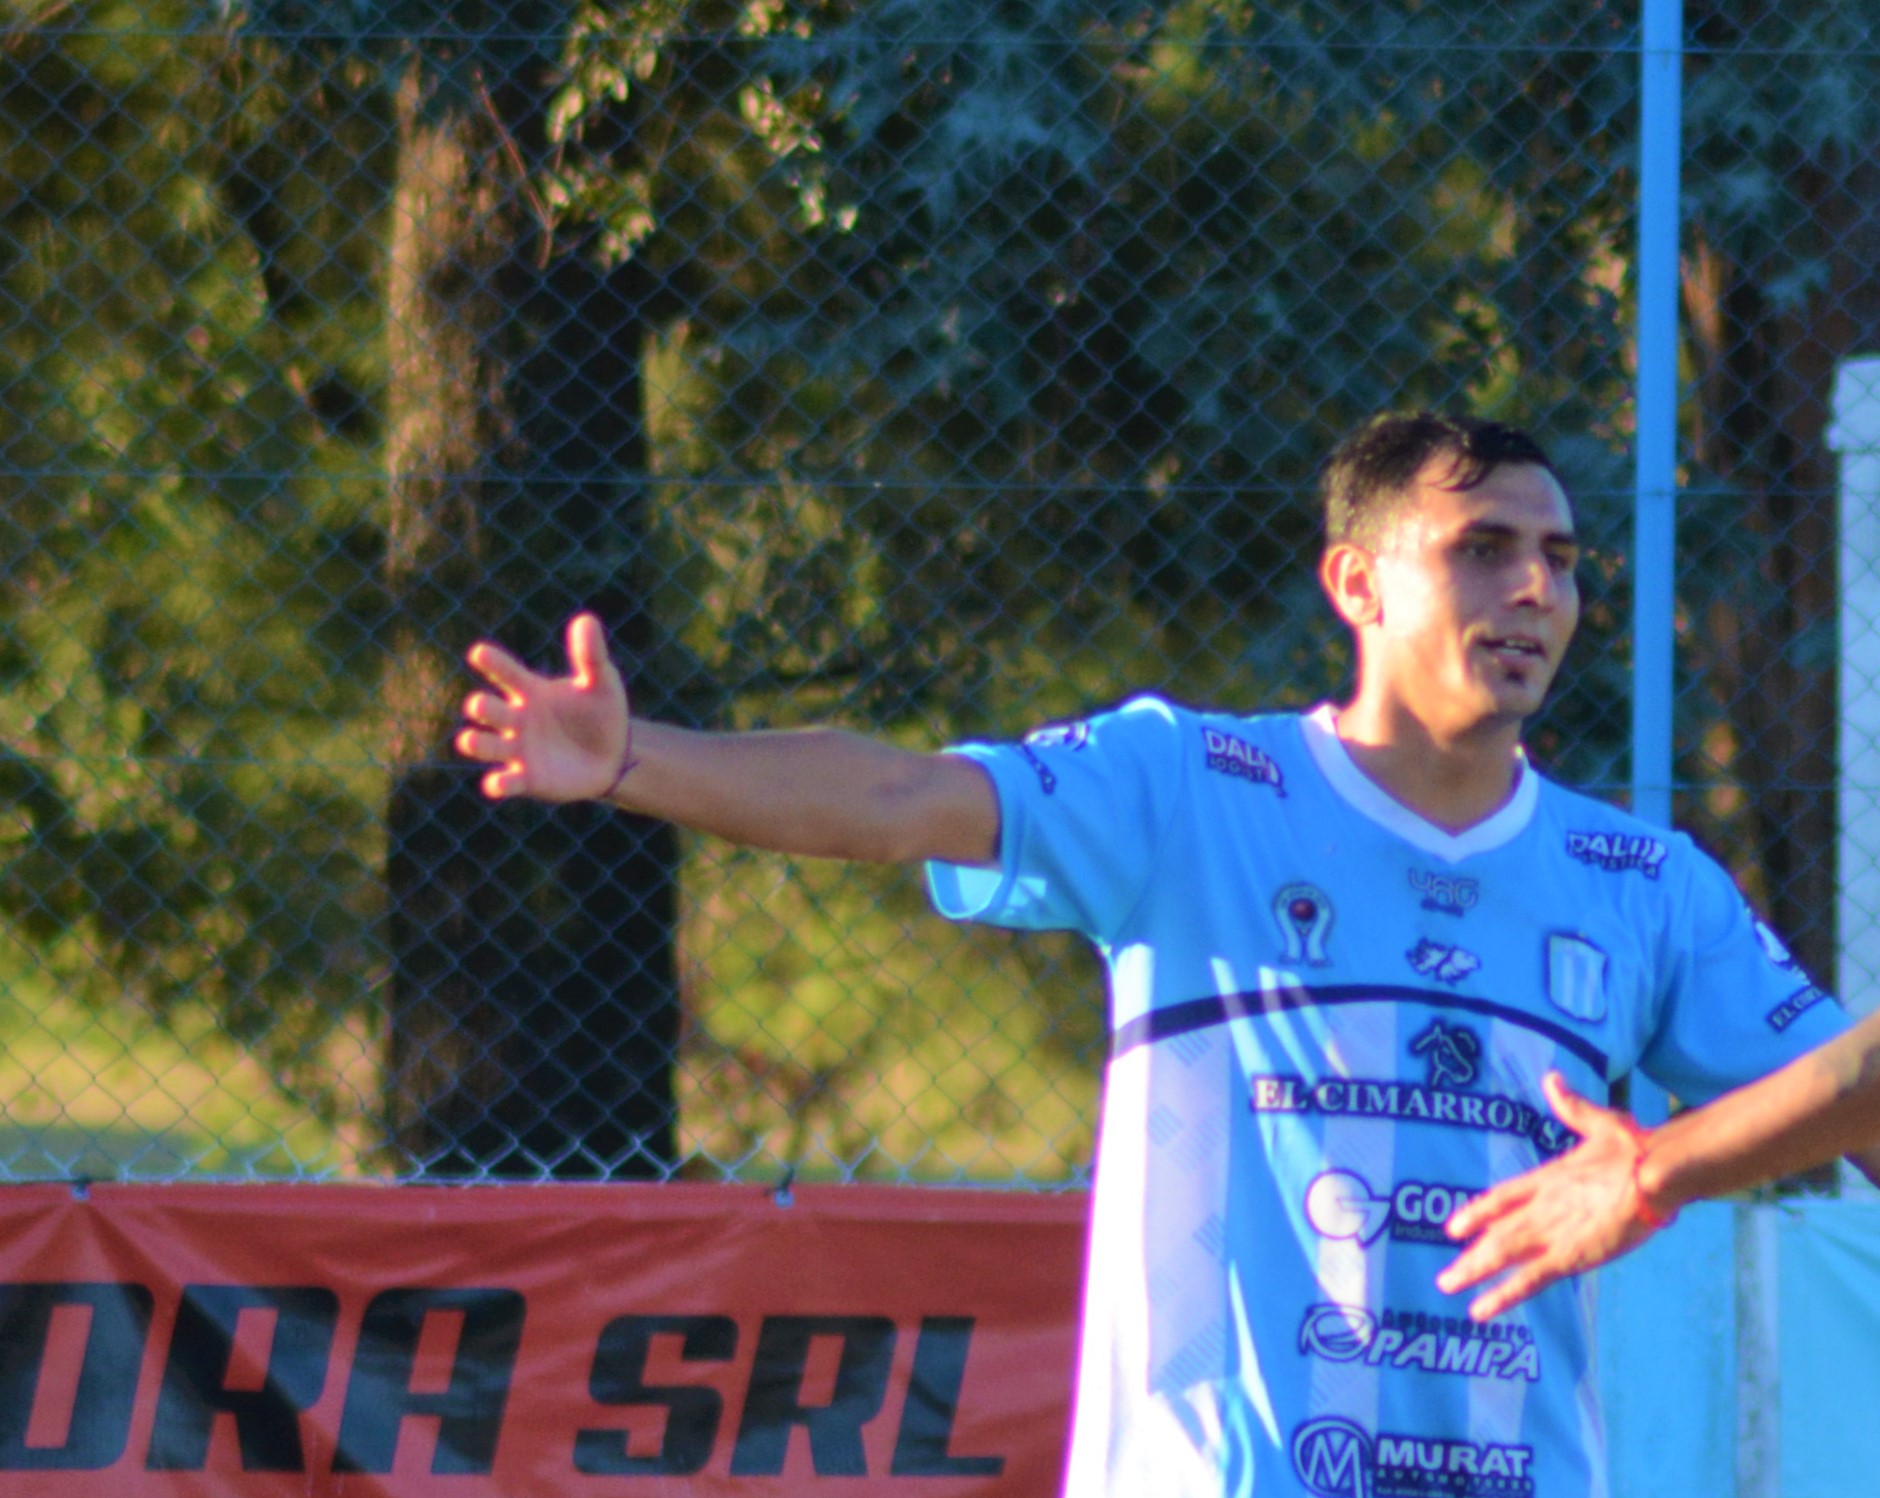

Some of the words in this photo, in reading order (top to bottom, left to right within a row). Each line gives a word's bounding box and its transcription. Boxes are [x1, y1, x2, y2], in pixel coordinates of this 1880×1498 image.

[1254, 1076, 1307, 1111] EL
[1366, 1325, 1541, 1382] PAMPA
[0, 1282, 527, 1475] DRA
[572, 1315, 1006, 1477] SRL
[1376, 1434, 1532, 1478] MURAT
